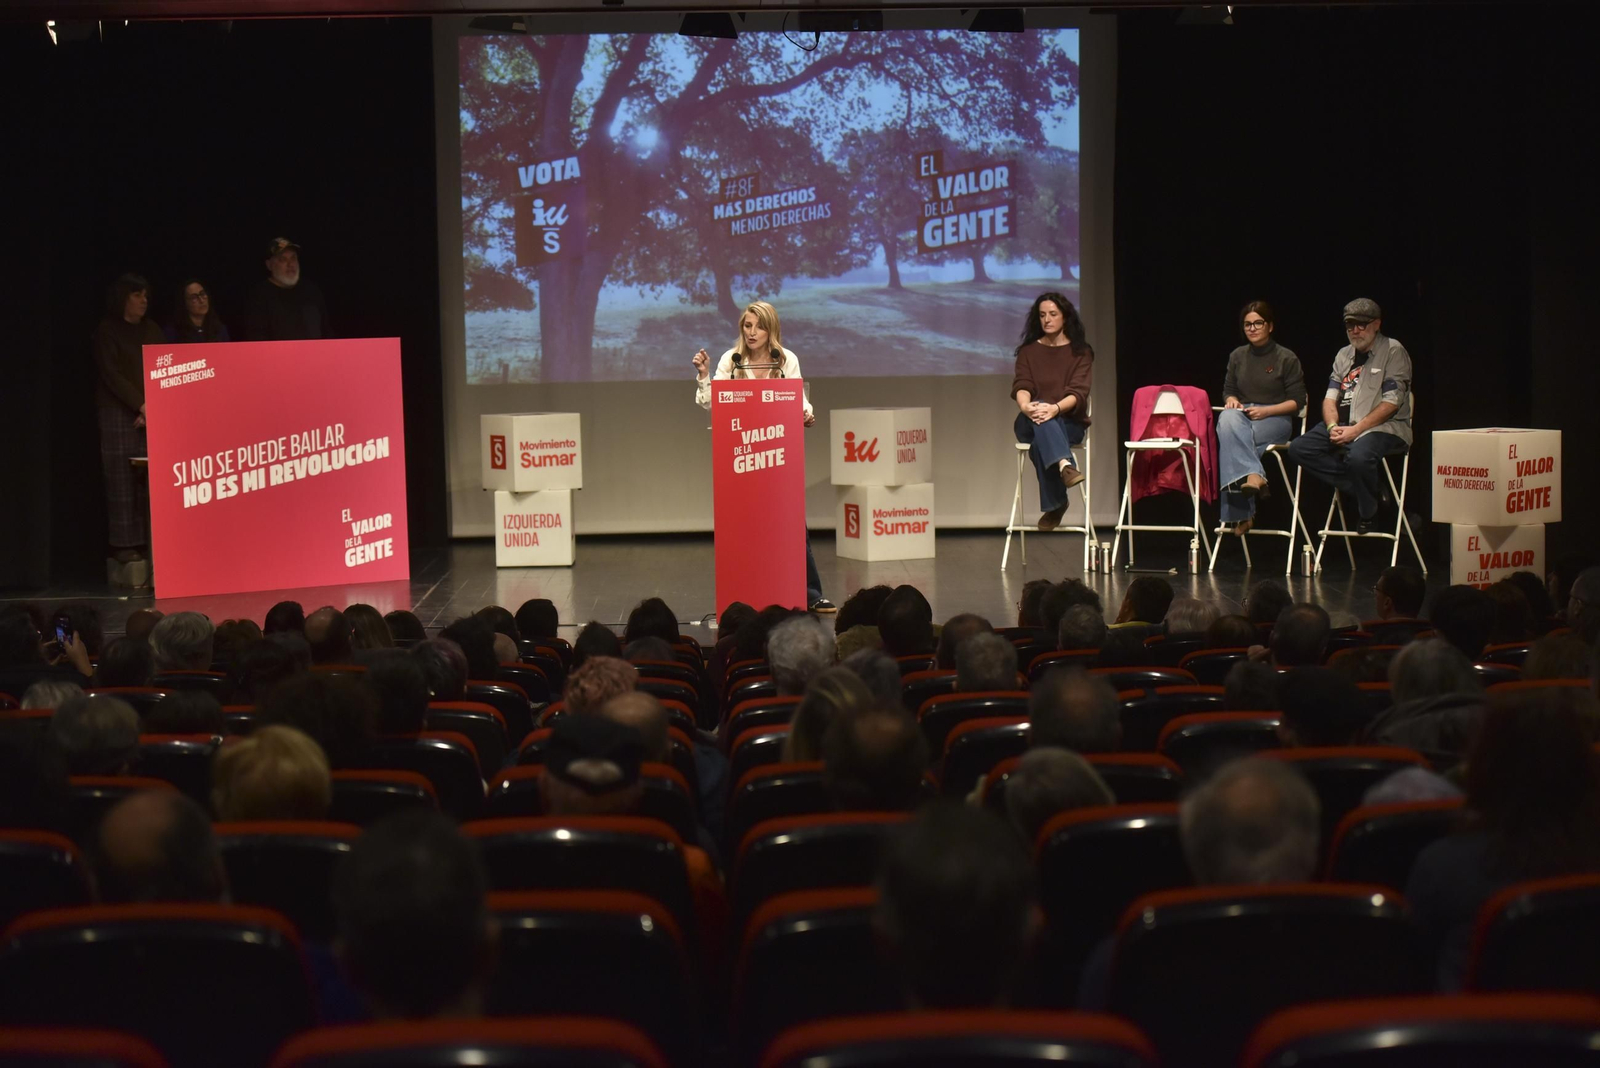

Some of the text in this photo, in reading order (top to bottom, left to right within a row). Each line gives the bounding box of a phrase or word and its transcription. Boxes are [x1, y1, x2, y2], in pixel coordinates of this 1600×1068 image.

[518, 157, 580, 188] VOTA
[921, 155, 938, 176] EL
[725, 177, 755, 199] #8F
[937, 165, 1009, 199] VALOR
[745, 187, 816, 213] DERECHOS
[925, 200, 954, 217] DE LA
[731, 202, 831, 236] MENOS DERECHAS
[923, 206, 1009, 248] GENTE
[156, 353, 173, 368] #8F
[168, 359, 206, 376] DERECHOS
[160, 368, 215, 389] MENOS DERECHAS
[731, 418, 742, 431] EL
[741, 424, 785, 445] VALOR
[897, 429, 927, 447] IZQUIERDA
[519, 439, 576, 451] Movimiento
[734, 444, 752, 456] DE LA
[1508, 444, 1518, 460] EL
[173, 423, 344, 486] SI NO SE PUEDE BAILAR
[520, 452, 576, 468] Sumar
[733, 447, 785, 474] GENTE
[897, 448, 916, 464] UNIDA
[183, 436, 389, 508] NO ES MI REVOLUCIÓN
[1452, 466, 1489, 478] DERECHOS
[1516, 456, 1554, 477] VALOR
[1443, 478, 1495, 491] MENOS DERECHAS
[1508, 479, 1524, 491] DE LA
[1506, 486, 1551, 514] GENTE
[342, 508, 353, 523] EL
[503, 513, 562, 530] IZQUIERDA
[873, 508, 929, 519] Movimiento
[351, 513, 392, 537] VALOR
[873, 519, 929, 536] Sumar
[345, 535, 362, 549] DE LA
[504, 532, 539, 547] UNIDA
[1467, 536, 1481, 551] EL
[345, 537, 393, 567] GENTE
[1479, 550, 1534, 569] VALOR
[1467, 571, 1490, 582] DE LA
